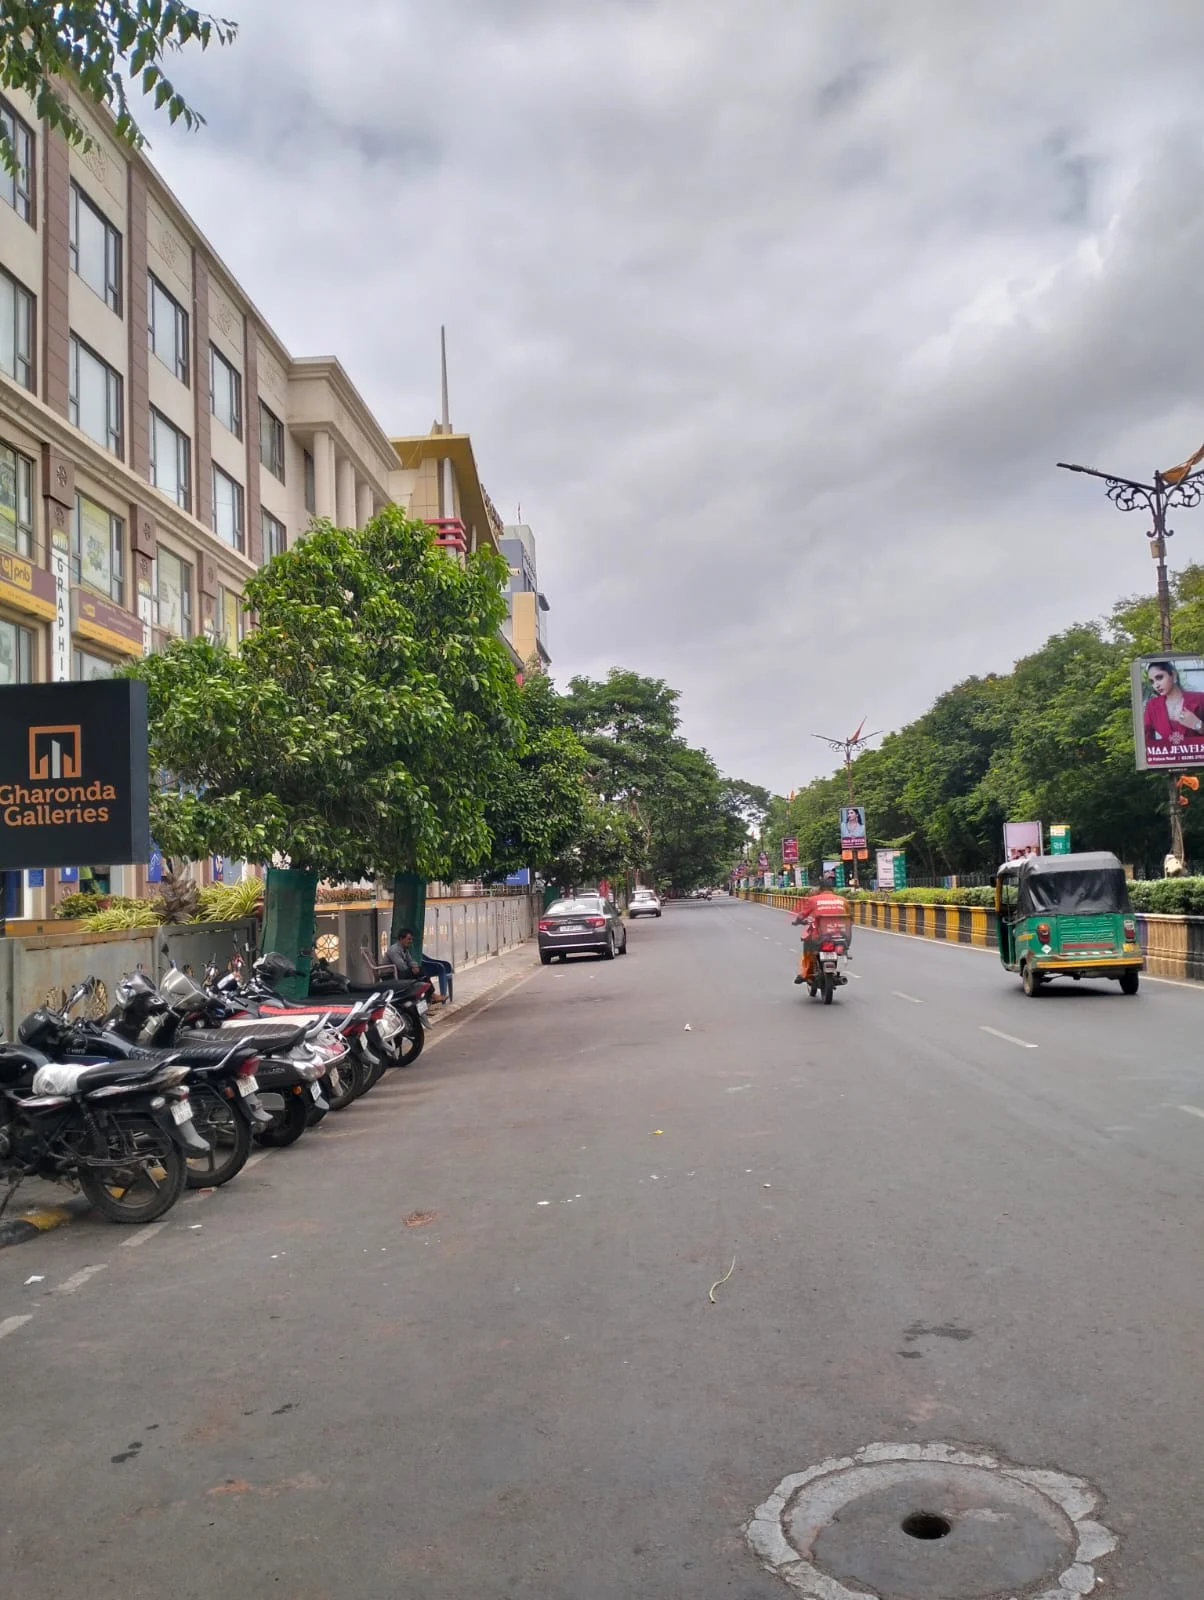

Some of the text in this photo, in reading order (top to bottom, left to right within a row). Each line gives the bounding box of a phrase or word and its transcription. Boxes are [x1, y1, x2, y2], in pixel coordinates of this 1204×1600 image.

[14, 566, 31, 582] pnb
[1147, 746, 1169, 755] MAA
[0, 781, 116, 805] Gharonda
[4, 804, 109, 827] Galleries
